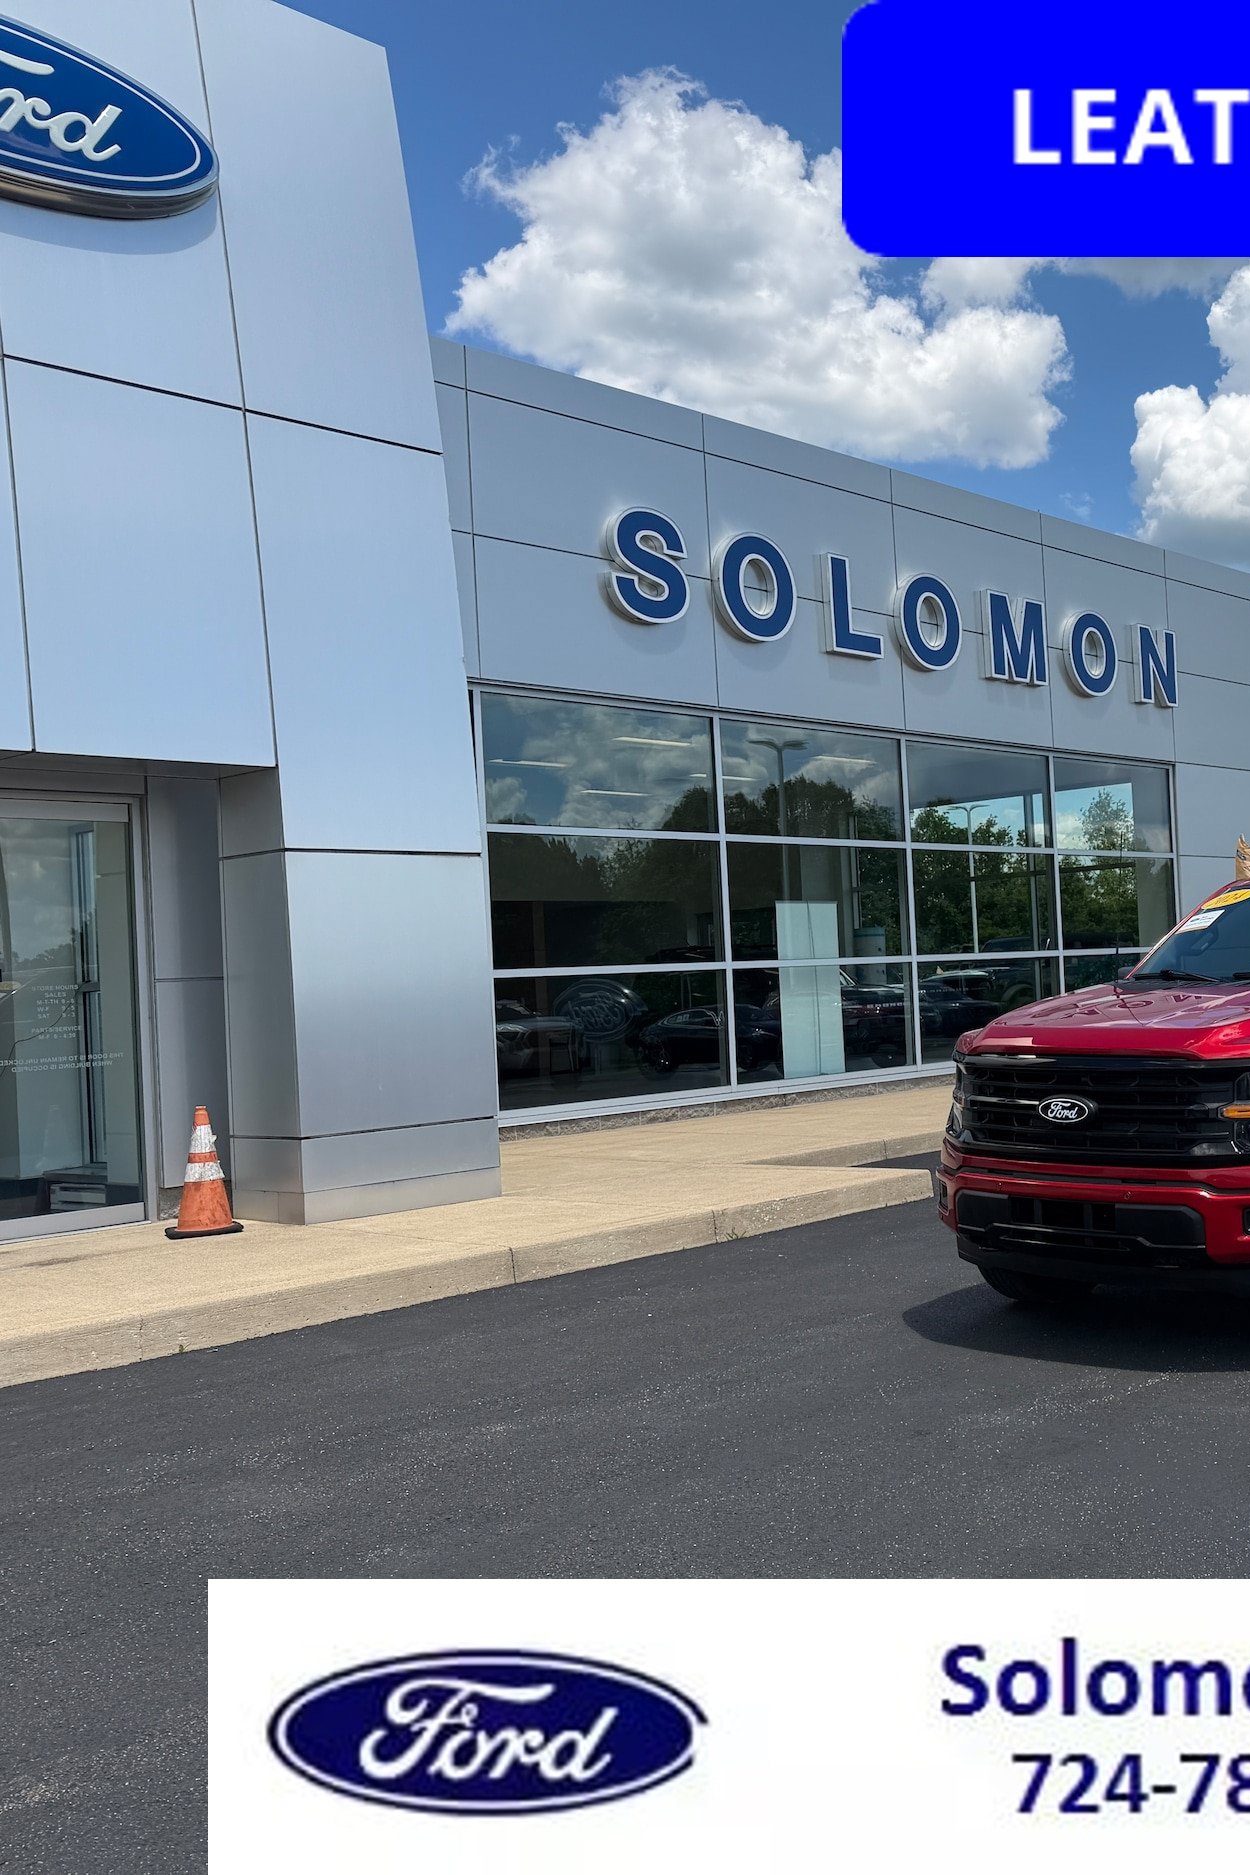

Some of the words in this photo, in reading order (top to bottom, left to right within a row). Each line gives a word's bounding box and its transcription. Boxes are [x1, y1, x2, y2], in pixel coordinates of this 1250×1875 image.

[0, 50, 123, 162] rd
[600, 505, 1180, 709] SOLOMON
[1047, 1101, 1079, 1119] Ford
